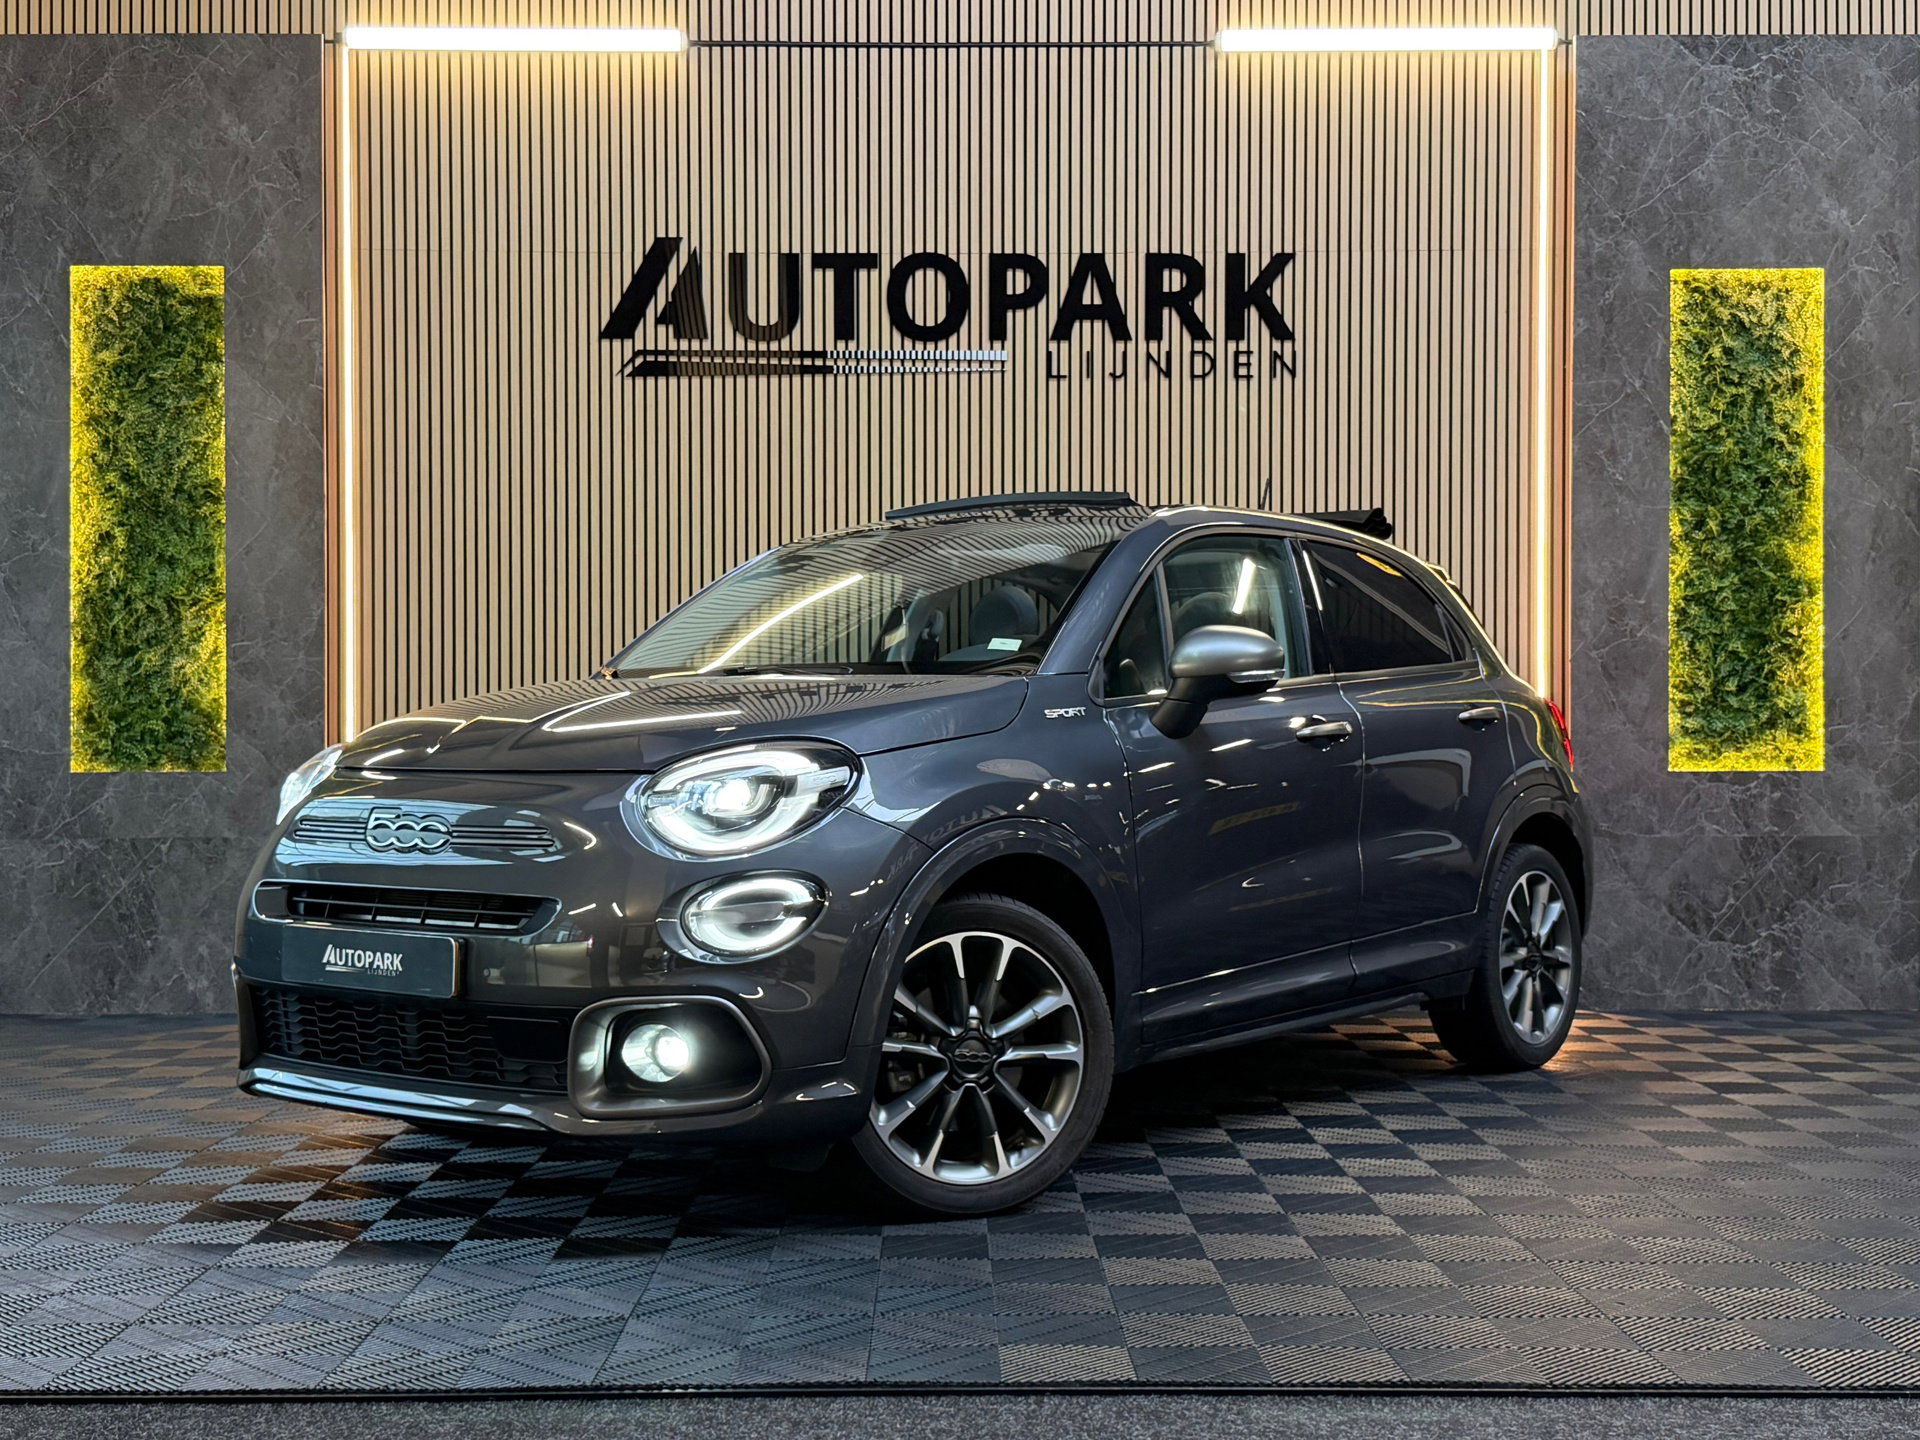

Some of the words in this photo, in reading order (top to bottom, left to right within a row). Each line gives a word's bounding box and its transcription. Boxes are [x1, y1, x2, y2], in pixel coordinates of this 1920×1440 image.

[600, 237, 1295, 342] AUTOPARK
[1046, 350, 1297, 379] LIJNDEN
[1044, 706, 1087, 719] SPORT
[365, 807, 452, 855] 500
[321, 943, 403, 972] AUTOPARK
